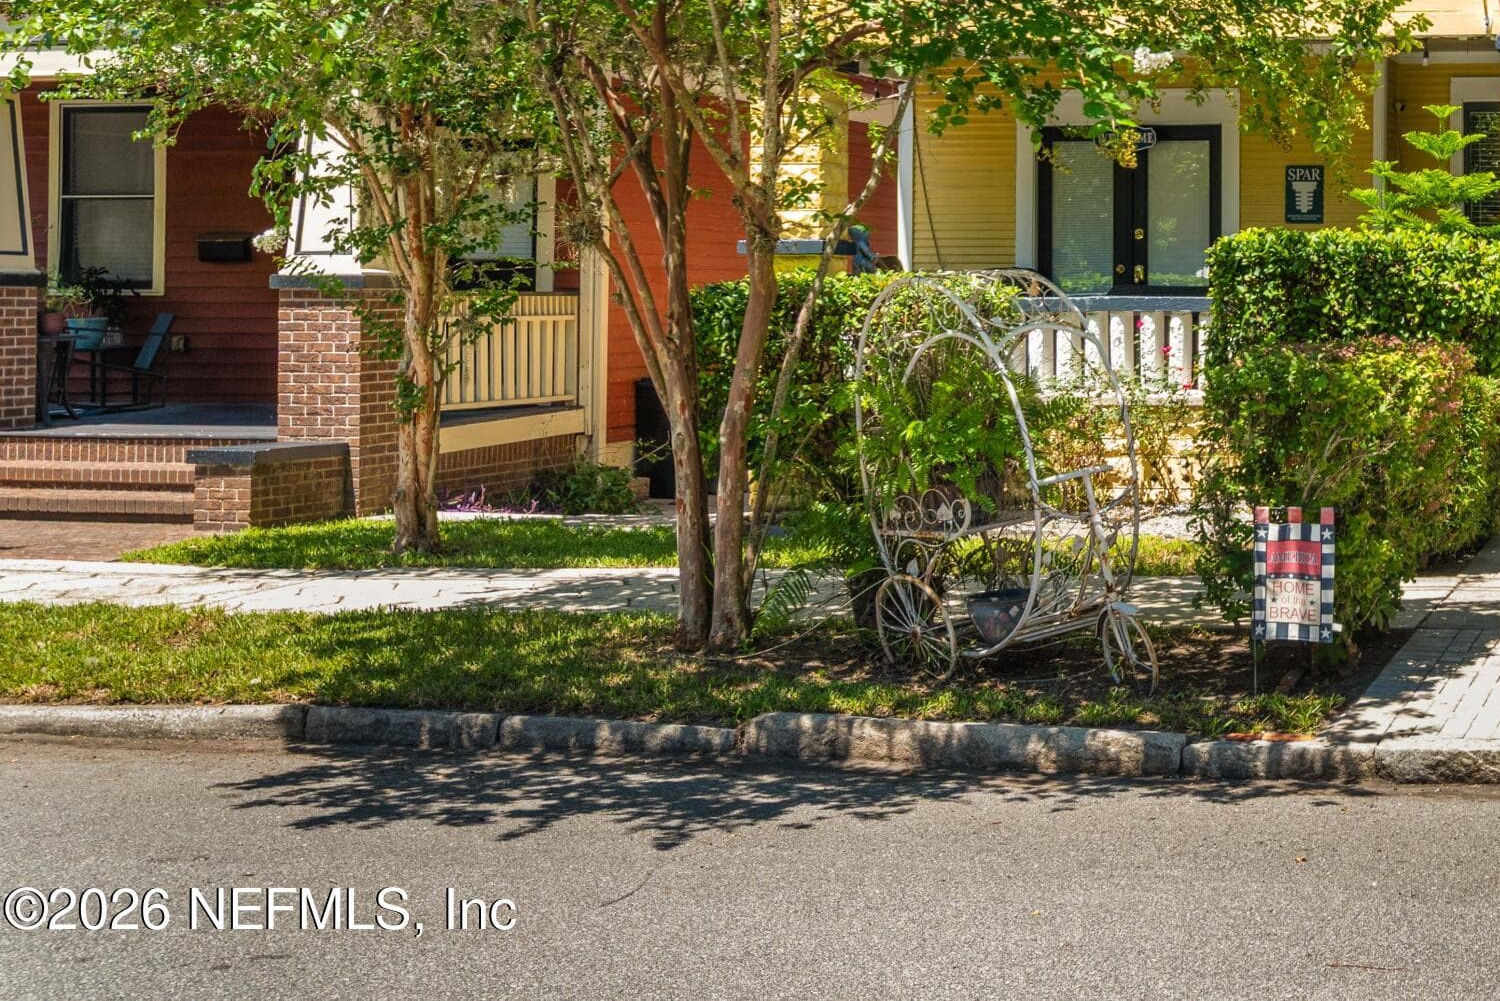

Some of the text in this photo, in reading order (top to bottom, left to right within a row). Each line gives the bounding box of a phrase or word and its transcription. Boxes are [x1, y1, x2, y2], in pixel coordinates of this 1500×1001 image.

[1287, 168, 1321, 180] SPAR
[1272, 581, 1314, 596] HOME
[1281, 595, 1291, 605] of
[1269, 606, 1318, 622] BRAVE
